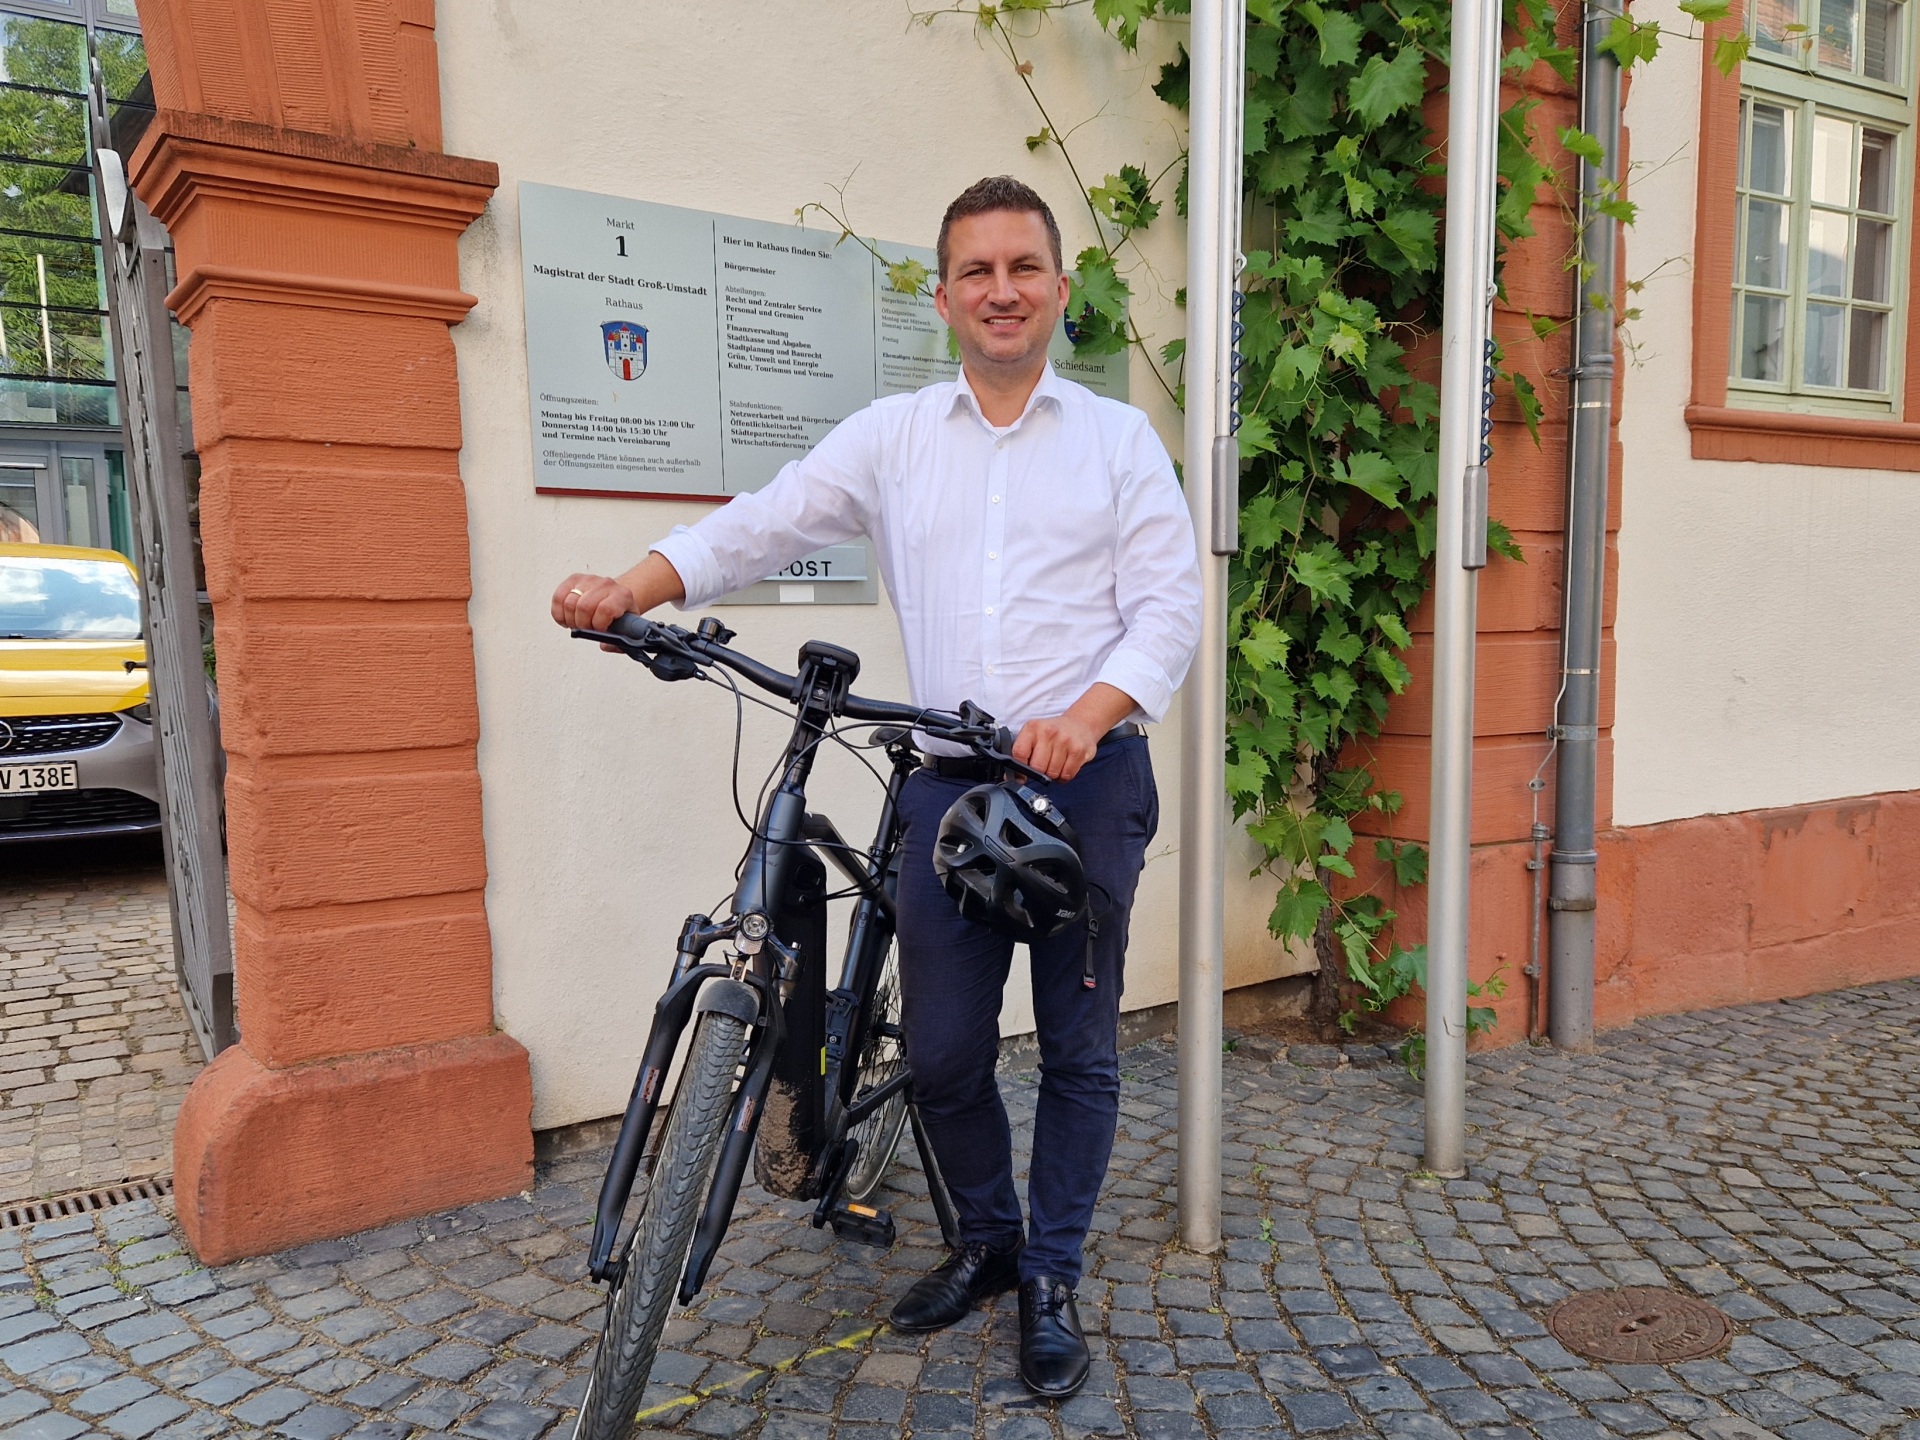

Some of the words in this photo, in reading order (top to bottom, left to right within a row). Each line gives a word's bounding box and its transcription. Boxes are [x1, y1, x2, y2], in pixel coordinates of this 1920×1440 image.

[606, 218, 635, 230] Markt
[615, 236, 629, 257] 1
[723, 236, 741, 246] Hier
[744, 239, 754, 248] im
[756, 241, 789, 253] Rathaus
[791, 246, 816, 257] finden
[818, 250, 832, 259] Sie:
[724, 262, 776, 276] Bürgermeister
[533, 264, 584, 280] Magistrat
[588, 272, 605, 282] der
[608, 274, 635, 287] Stadt
[637, 279, 707, 296] Groß-Umstadt
[725, 286, 766, 297] Abteilungen:
[605, 297, 644, 310] Rathaus
[725, 295, 746, 304] Recht
[763, 300, 796, 310] Zentraler
[797, 304, 822, 313] Service
[726, 304, 757, 315] Personal
[774, 310, 804, 320] Gremien
[726, 324, 789, 338] Finanzverwaltung
[727, 333, 765, 344] Stadtkasse
[781, 340, 811, 349] Abgaben
[727, 343, 775, 355] Stadtplanung
[776, 348, 790, 356] und
[791, 350, 822, 359] Baurecht
[727, 352, 748, 361] Grün,
[749, 355, 776, 364] Umwelt
[792, 359, 819, 368] Energie
[1055, 359, 1106, 374] Schiedsamt
[728, 361, 753, 371] Kultur,
[755, 364, 792, 374] Tourismus
[808, 370, 834, 379] Vereine
[540, 393, 599, 406] Öffnungszeiten:
[541, 411, 572, 421] Montag
[589, 415, 618, 424] Freitag
[620, 417, 642, 425] 08:00
[644, 418, 655, 426] bis
[658, 420, 679, 428] 12:00
[730, 410, 784, 421] Netzwerkarbeit
[541, 421, 589, 432] Donnerstag
[592, 424, 613, 432] 14:00
[615, 426, 627, 434] bis
[630, 427, 651, 435] 15:30
[730, 418, 803, 431] Öffentlichkeitsarbeit
[542, 431, 558, 439] und
[560, 432, 594, 441] Termine
[618, 436, 671, 447] Vereinbarung
[731, 428, 809, 440] Städtepartnerschaften
[731, 438, 805, 450] Wirtschaftsförderung
[543, 450, 595, 461] Offenliegende
[597, 453, 617, 462] Pläne
[619, 455, 645, 463] können
[558, 458, 614, 470] Öffnungszeiten
[616, 464, 656, 473] eingesehen
[658, 465, 684, 473] werden
[19, 766, 74, 788] 138E
